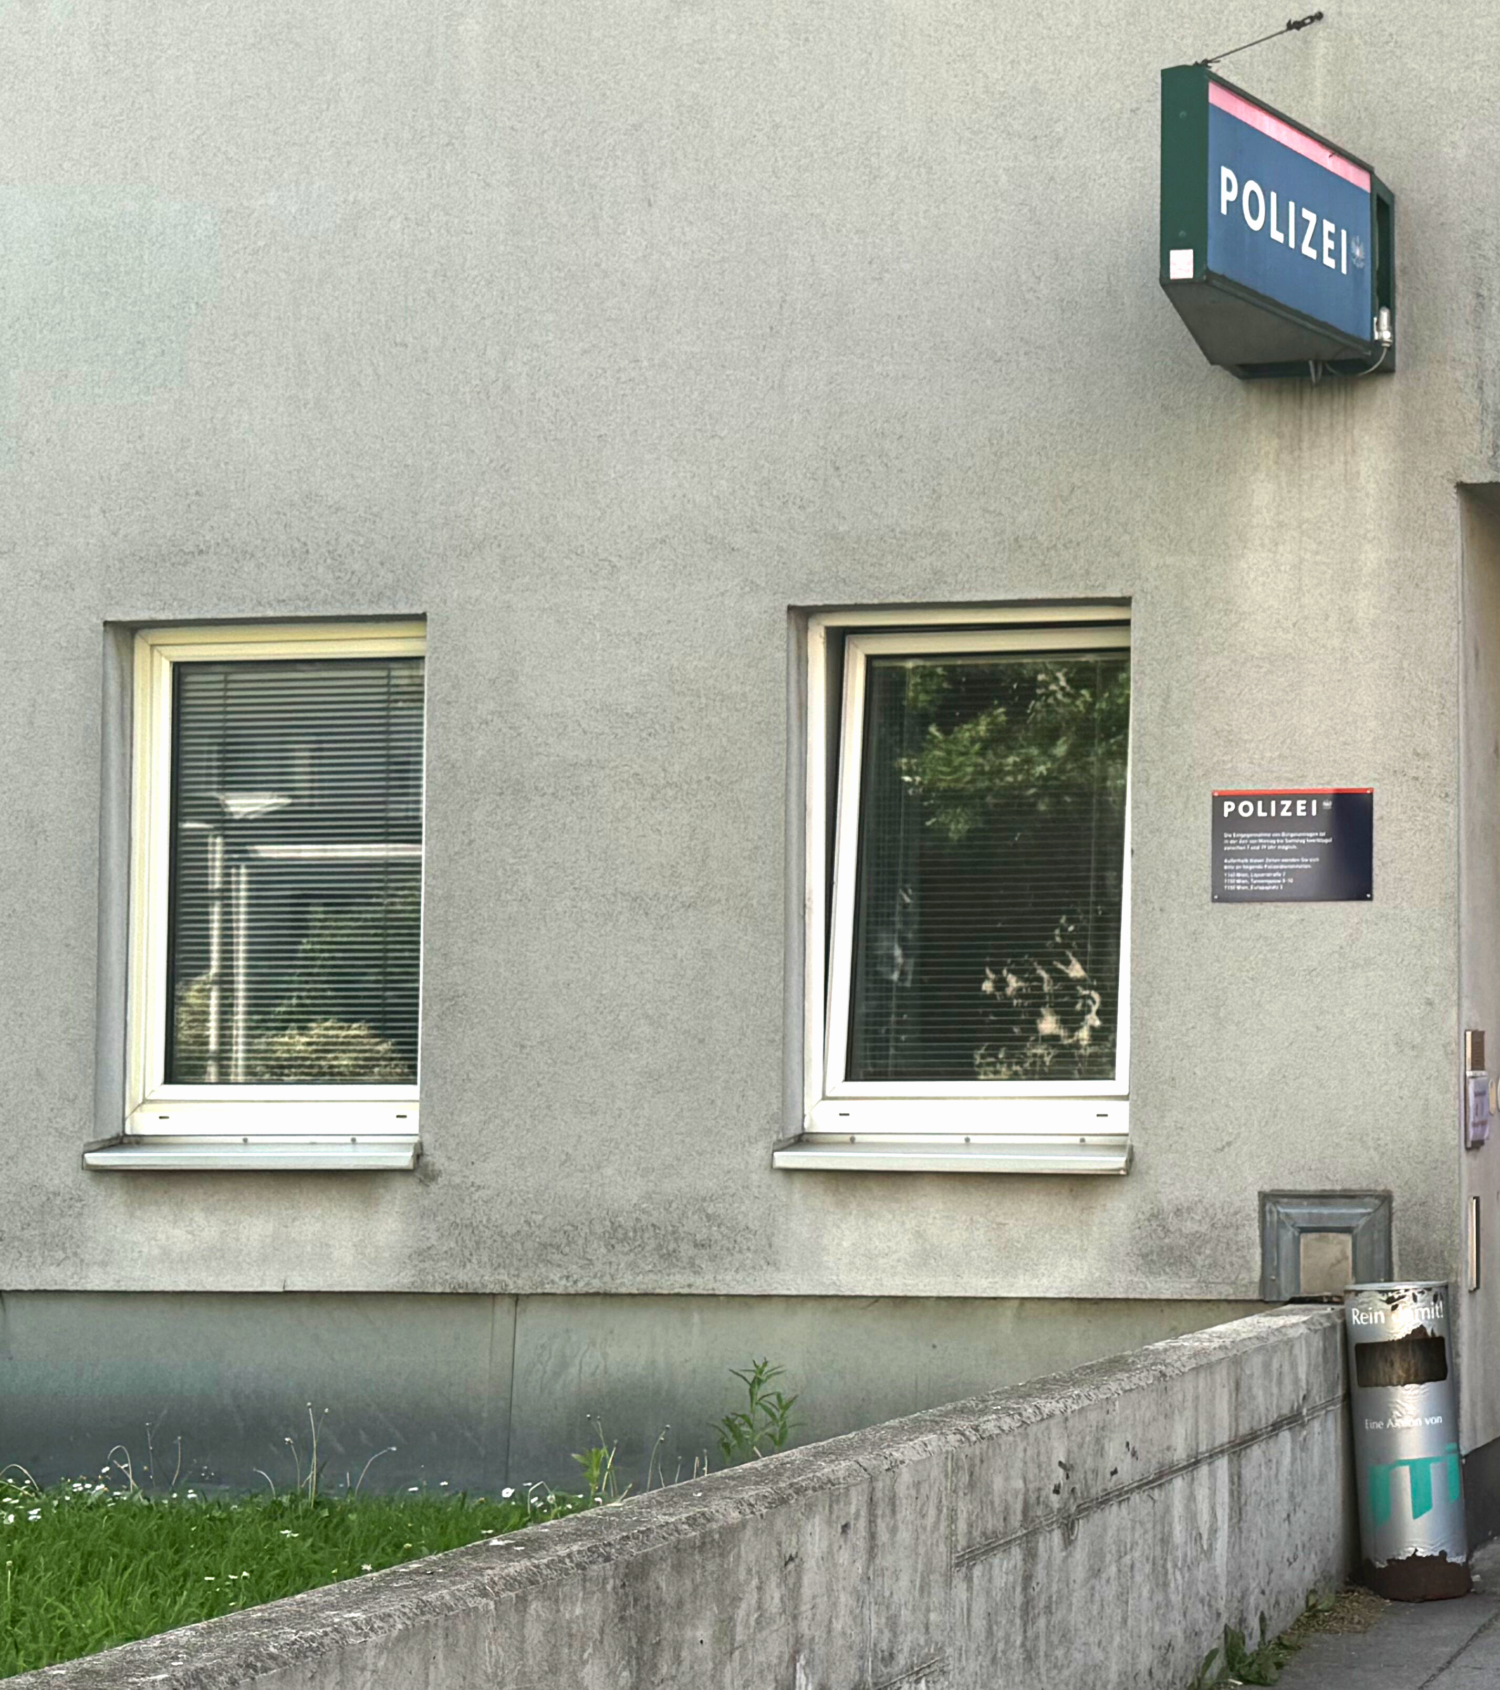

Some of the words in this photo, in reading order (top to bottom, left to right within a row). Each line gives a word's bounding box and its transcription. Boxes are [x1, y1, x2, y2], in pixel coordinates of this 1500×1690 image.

[1220, 165, 1347, 275] POLIZEI
[1223, 799, 1317, 818] POLIZEI
[1352, 1307, 1385, 1325] Rein
[1386, 1417, 1422, 1429] Aon
[1424, 1415, 1443, 1425] von
